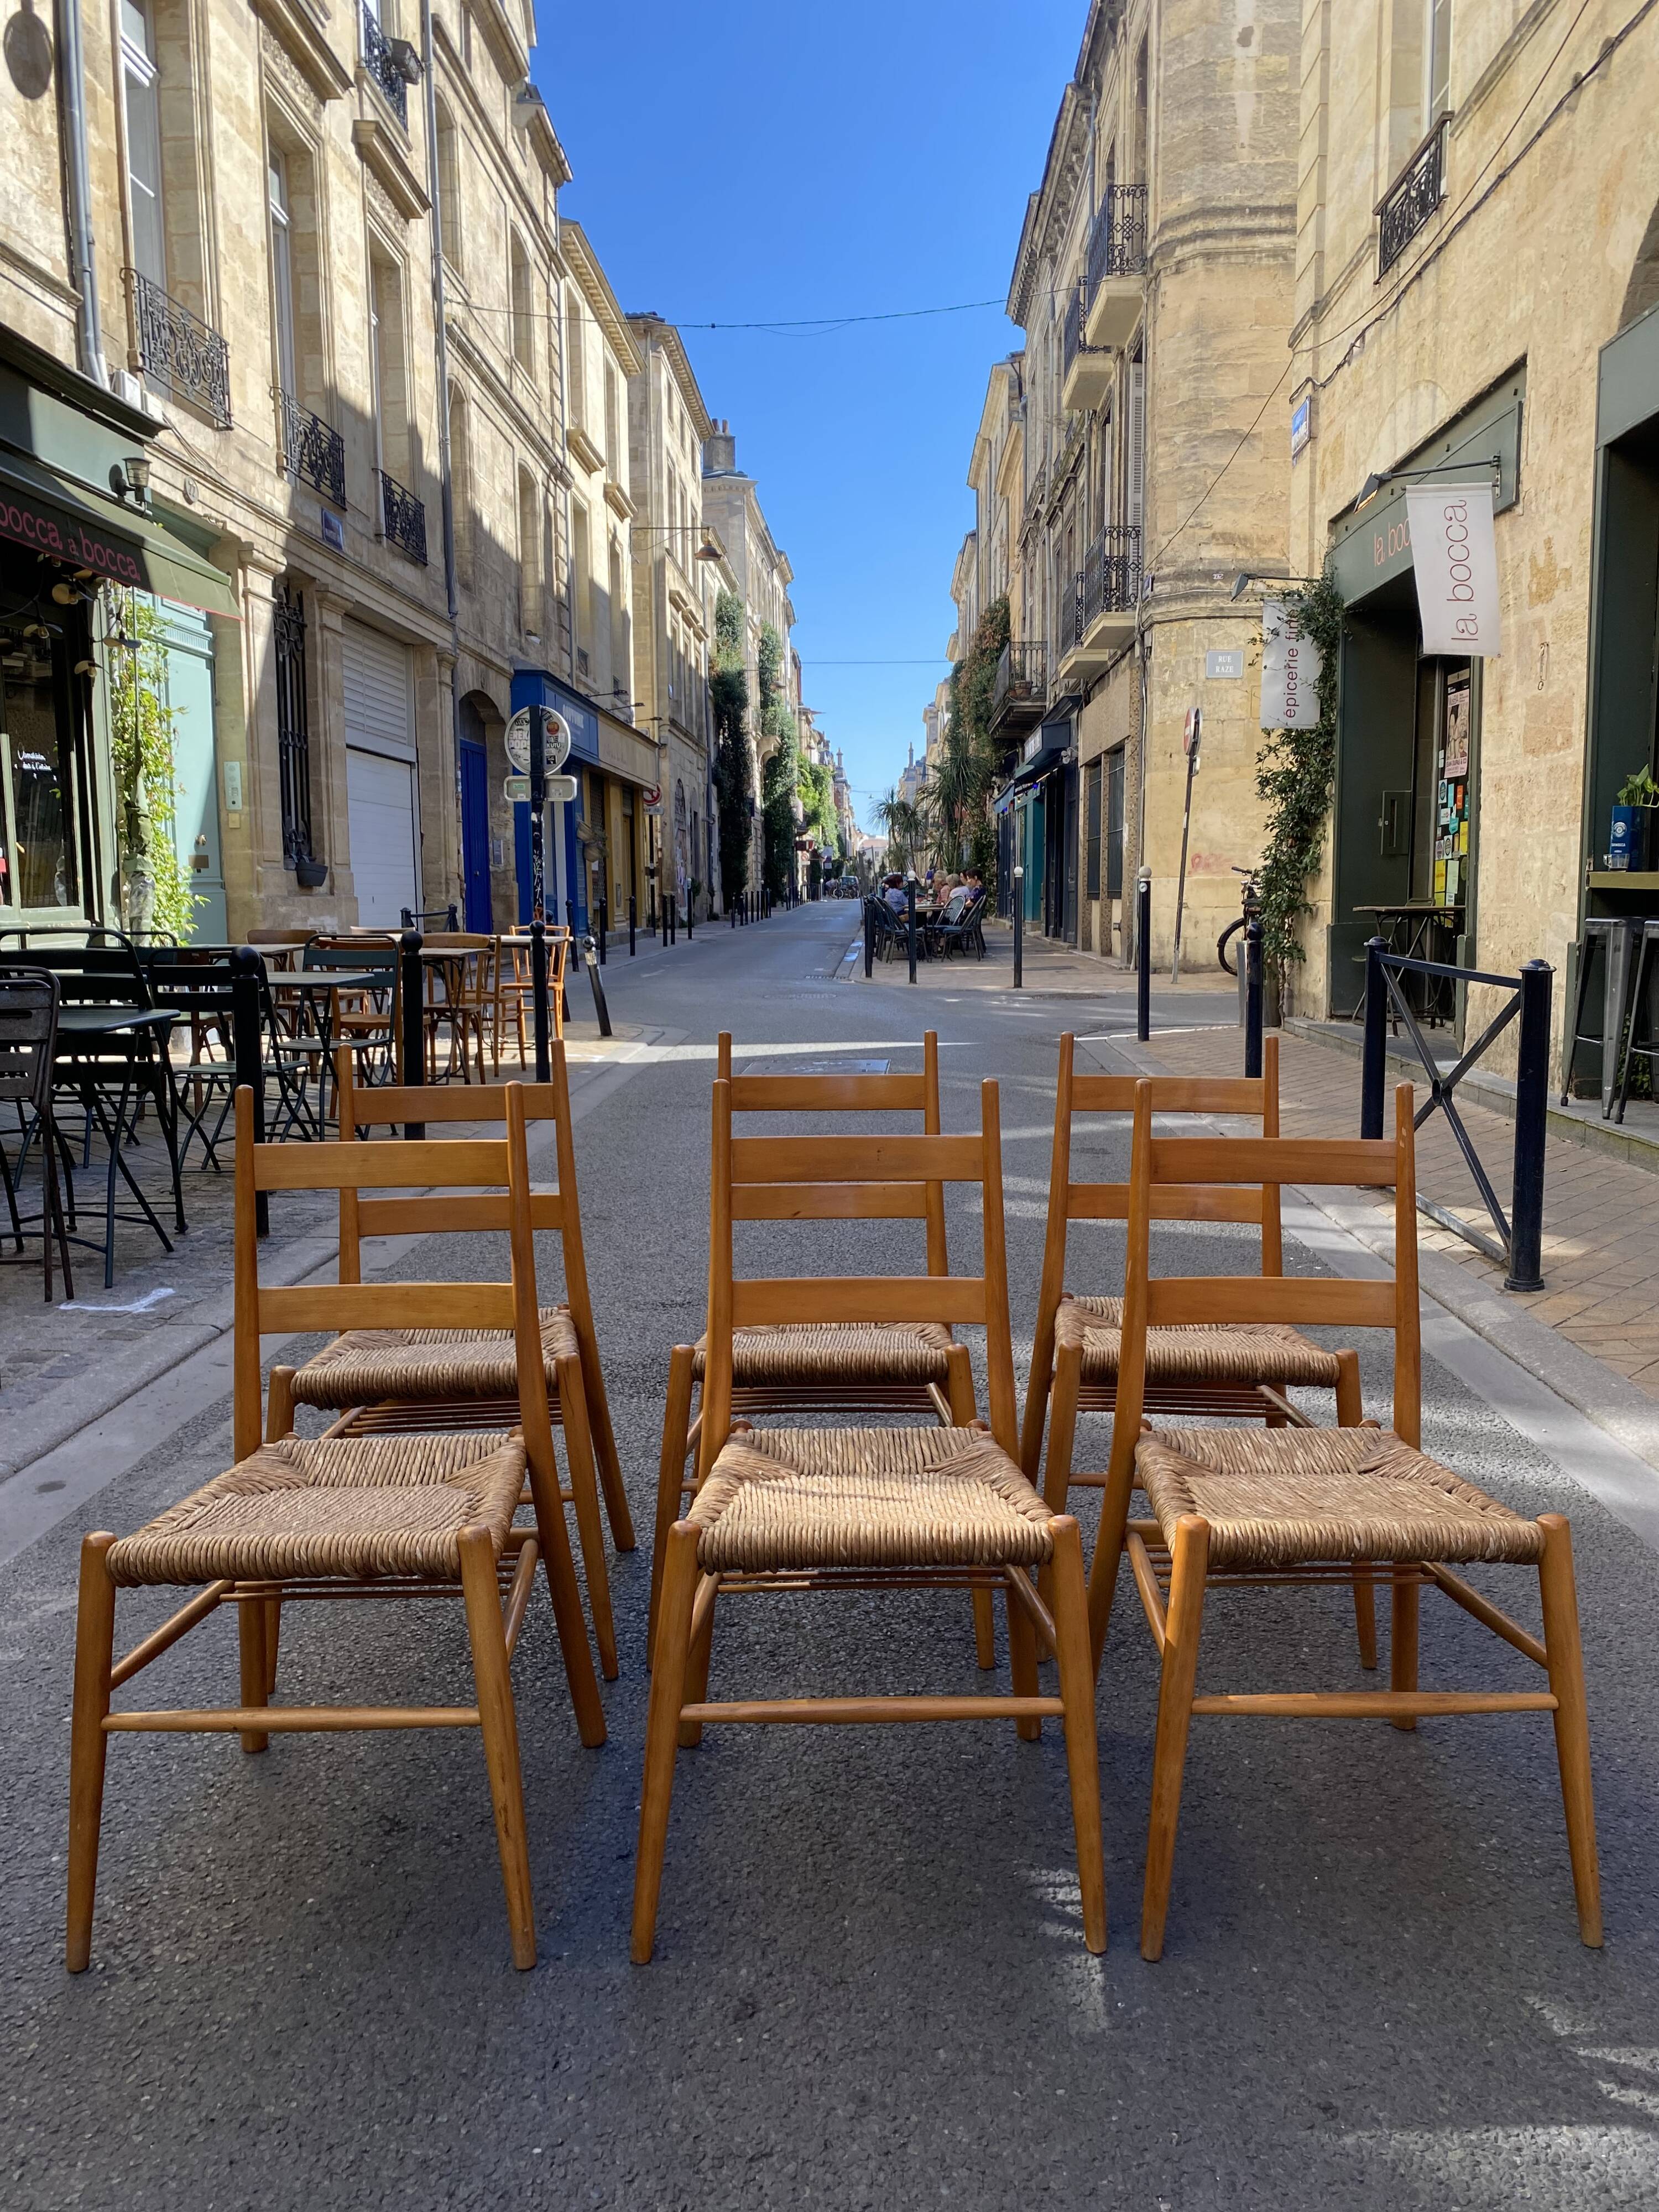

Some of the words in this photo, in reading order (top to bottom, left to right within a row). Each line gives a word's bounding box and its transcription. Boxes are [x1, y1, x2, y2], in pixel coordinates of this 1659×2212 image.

[67, 538, 79, 556] a
[79, 526, 142, 581] bocca
[1374, 532, 1385, 567] la
[1443, 499, 1475, 602] bocca
[1450, 613, 1479, 641] la
[1282, 648, 1300, 718] épicerie
